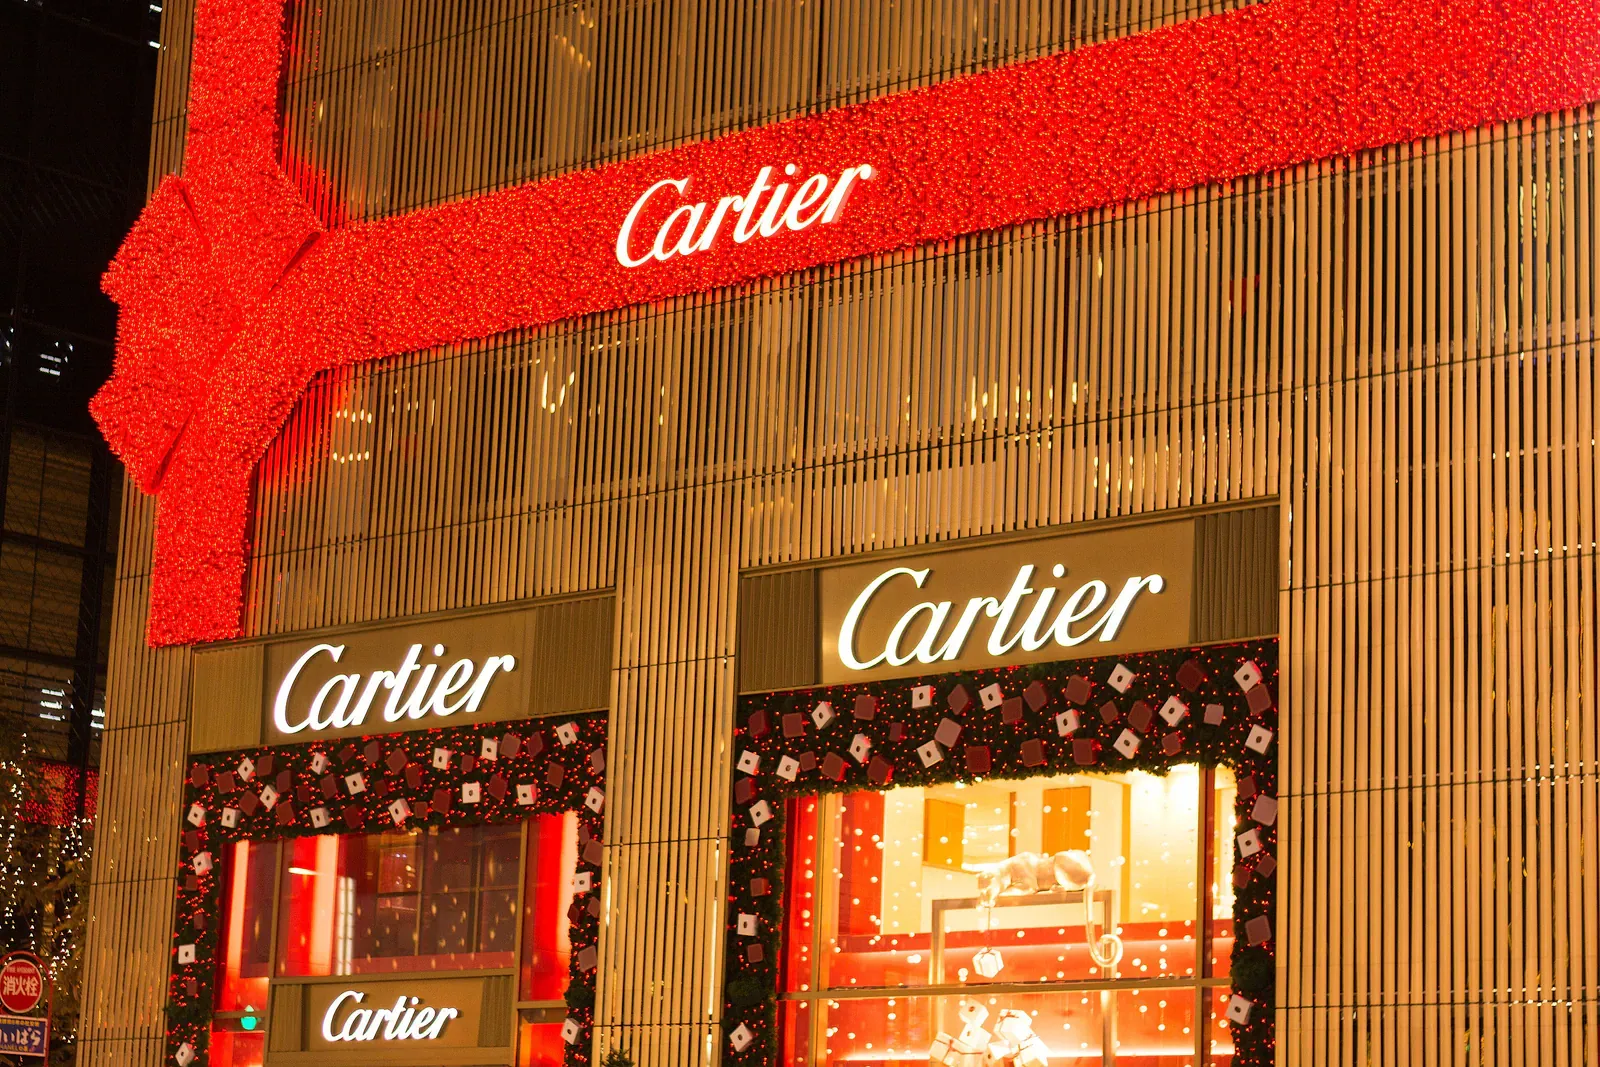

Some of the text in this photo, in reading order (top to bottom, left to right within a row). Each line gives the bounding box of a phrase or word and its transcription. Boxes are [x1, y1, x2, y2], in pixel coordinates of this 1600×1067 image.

[615, 163, 873, 268] Cartier
[837, 563, 1164, 671] Cartier
[273, 643, 515, 734] Cartier
[3, 976, 39, 997] 消火栓
[321, 990, 458, 1042] Cartier
[0, 1028, 41, 1046] いばら
